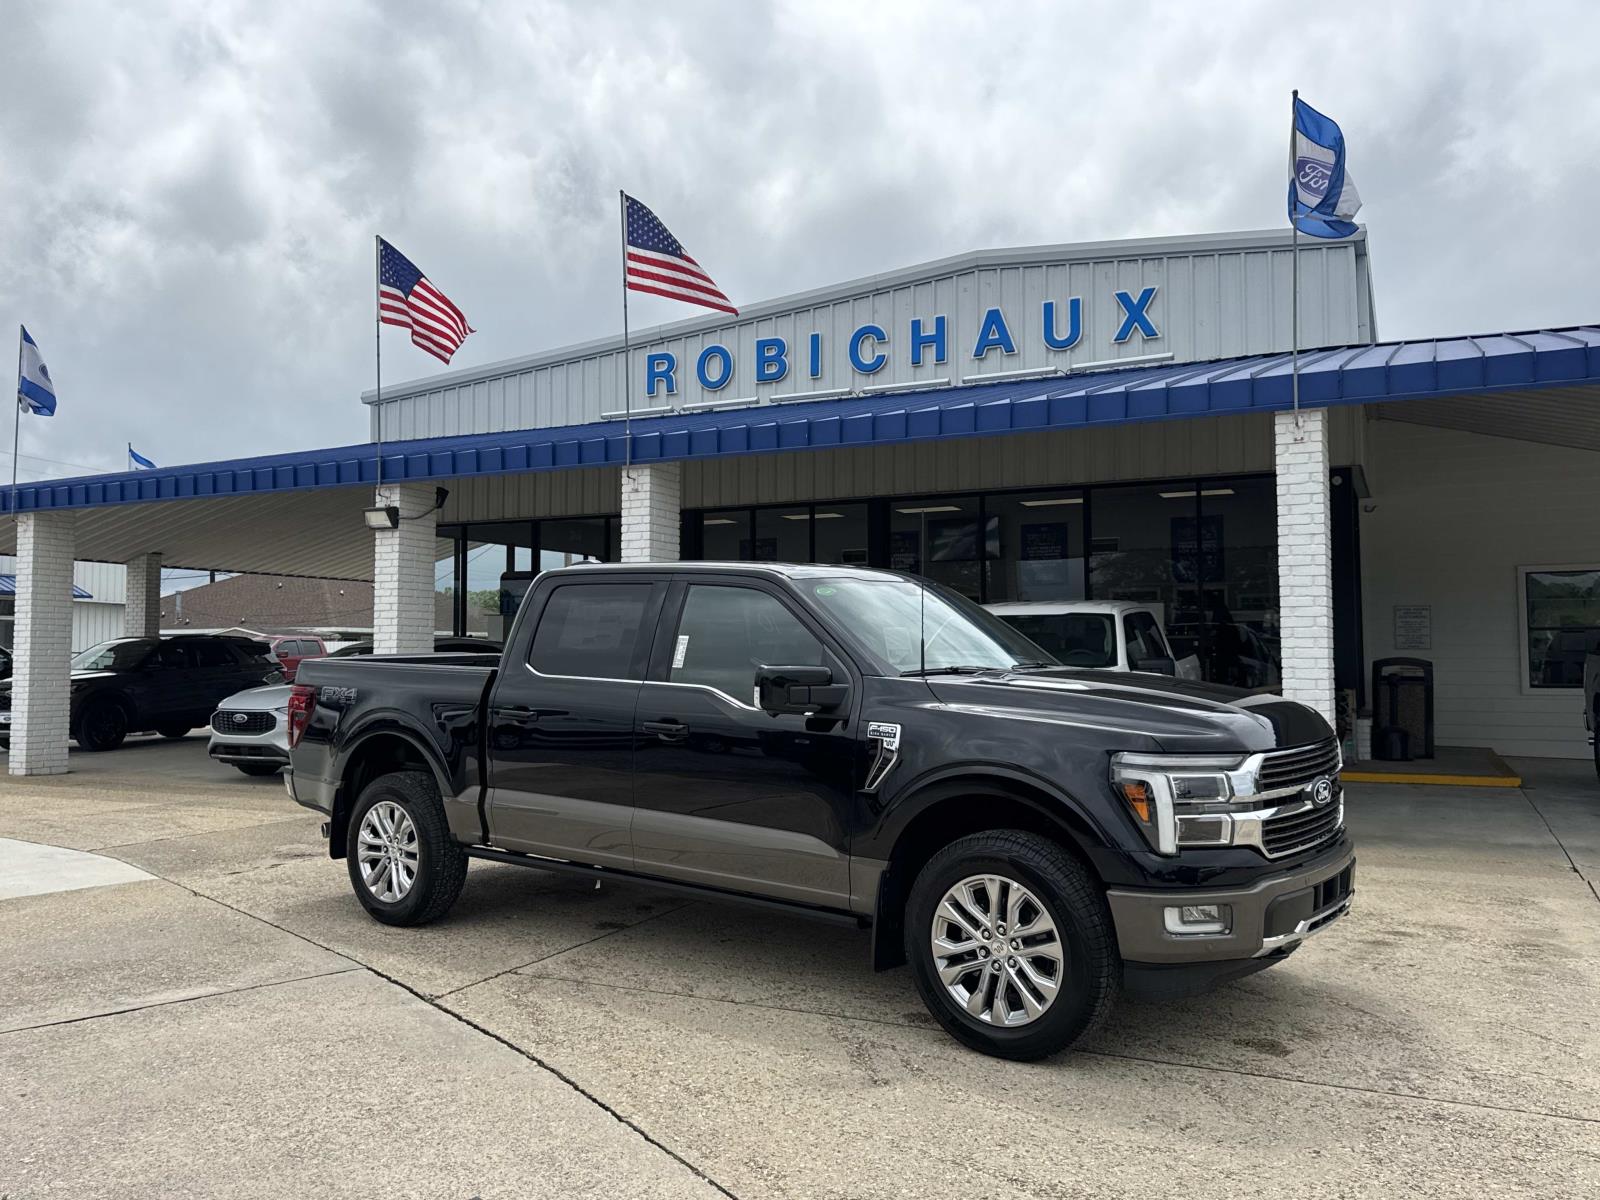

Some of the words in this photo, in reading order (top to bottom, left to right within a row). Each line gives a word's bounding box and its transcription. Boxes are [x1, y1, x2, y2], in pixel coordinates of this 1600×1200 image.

[1299, 162, 1332, 189] For
[646, 286, 1160, 397] ROBICHAUX
[321, 686, 357, 701] FX4
